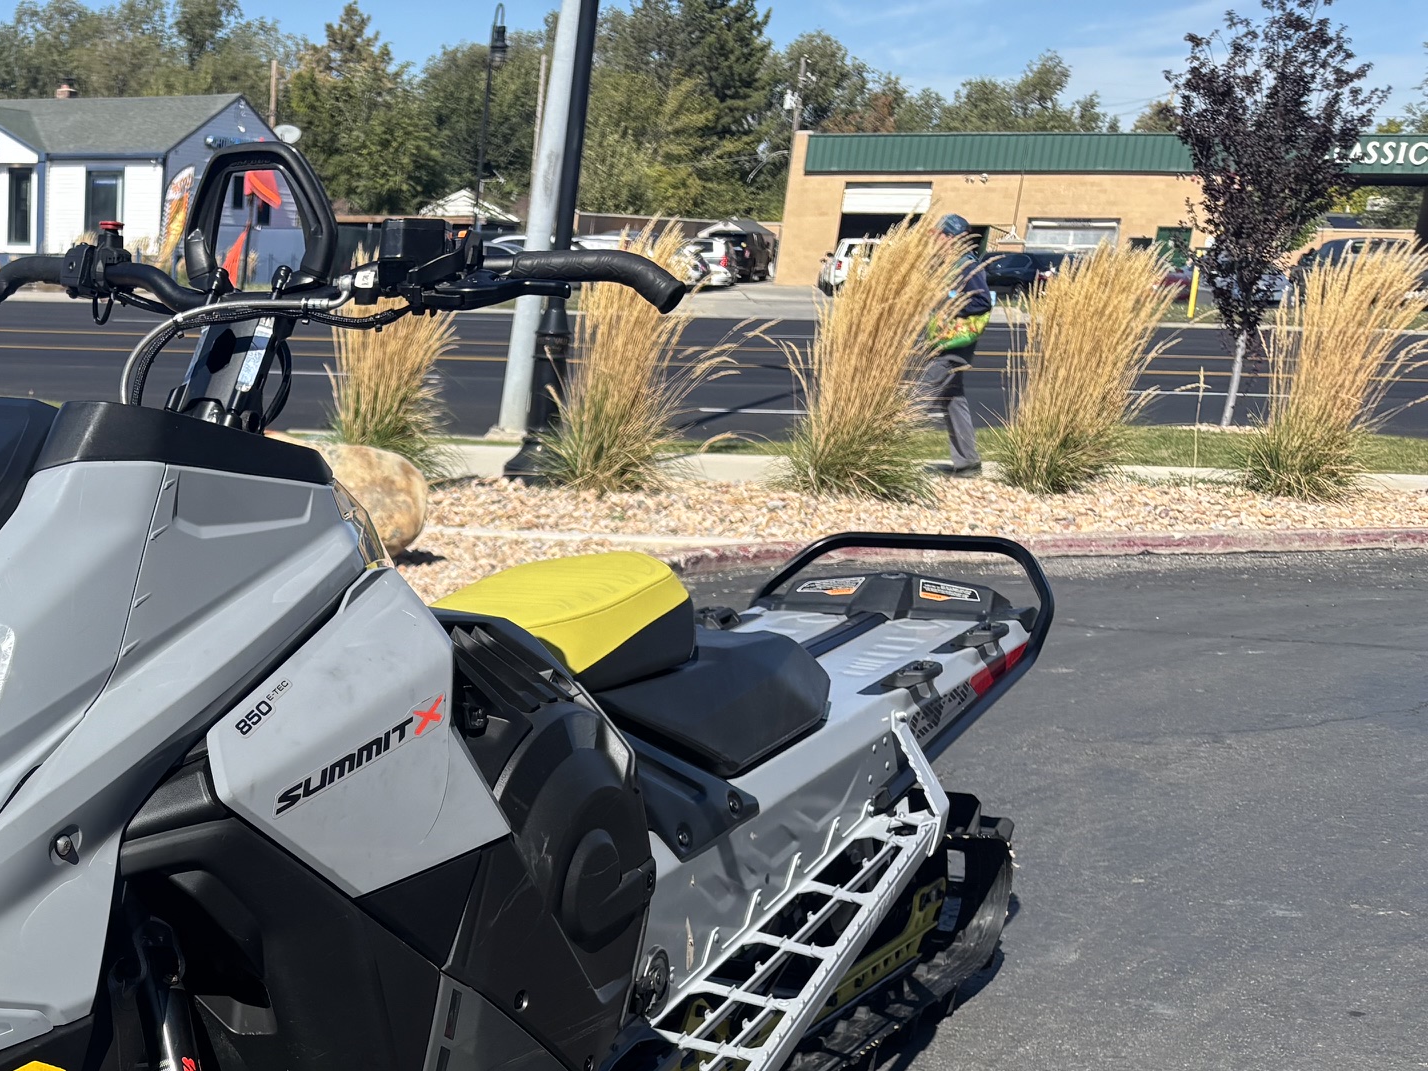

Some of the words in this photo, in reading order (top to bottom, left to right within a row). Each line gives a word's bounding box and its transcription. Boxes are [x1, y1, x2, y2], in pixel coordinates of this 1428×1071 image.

[235, 700, 273, 736] 850
[266, 679, 290, 702] E-TEC
[275, 716, 414, 816] SUMMIT
[412, 693, 444, 736] X
